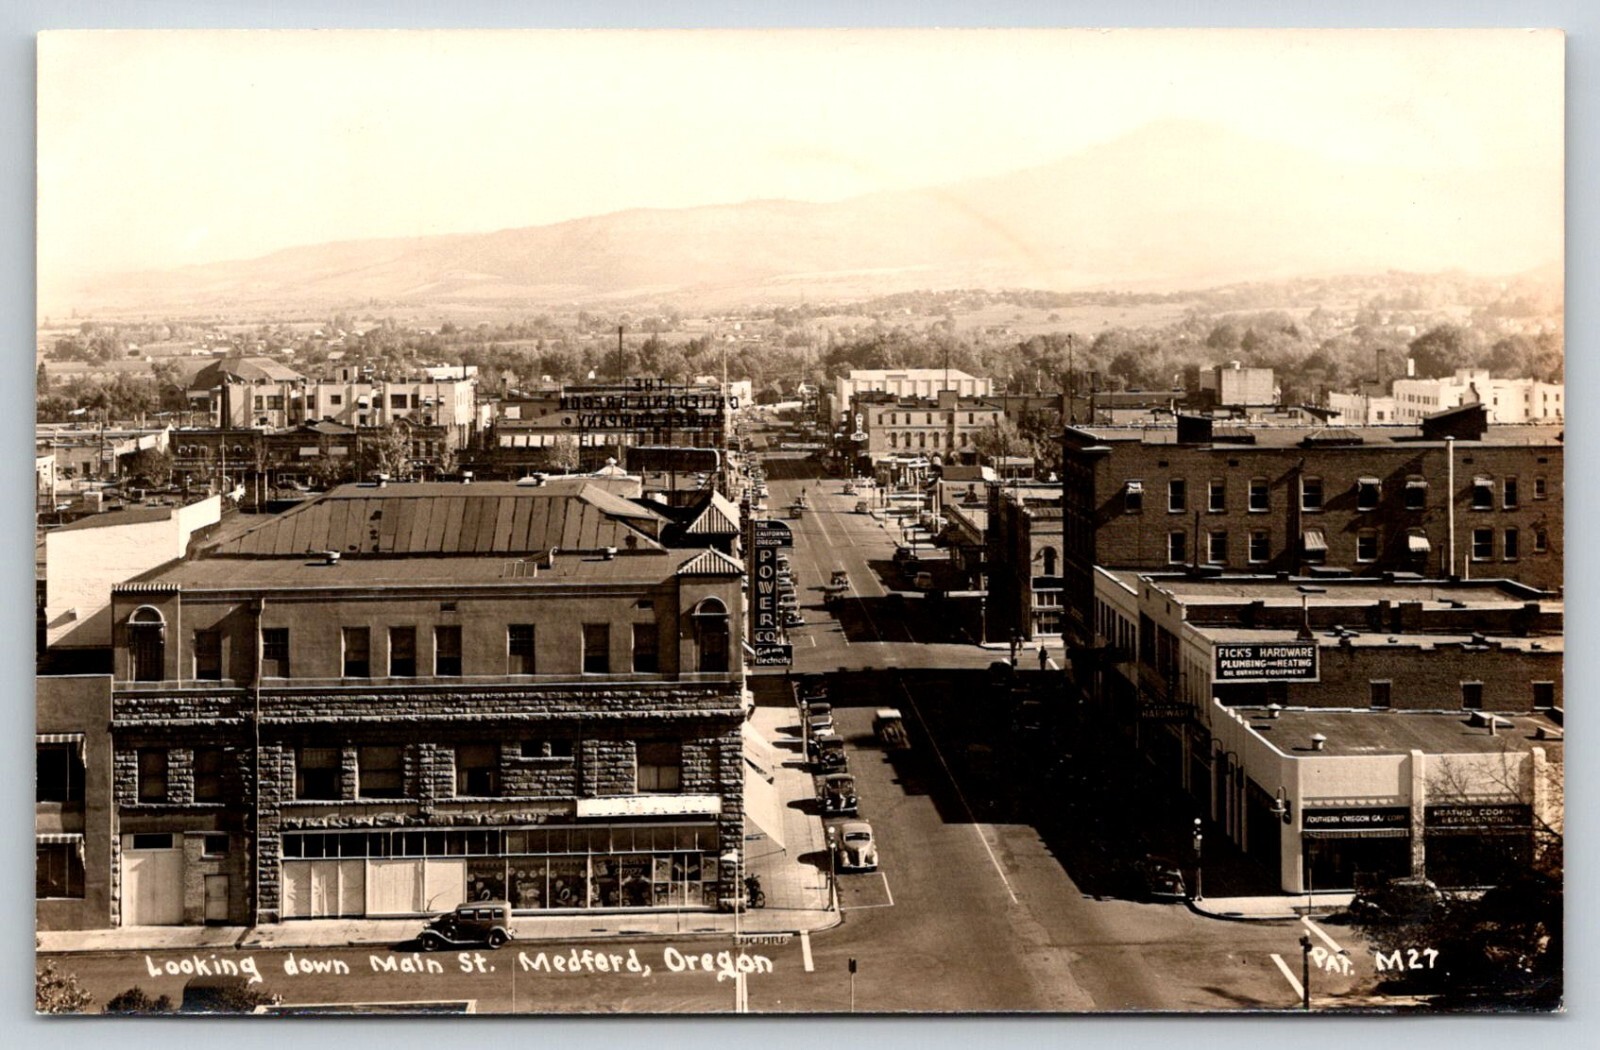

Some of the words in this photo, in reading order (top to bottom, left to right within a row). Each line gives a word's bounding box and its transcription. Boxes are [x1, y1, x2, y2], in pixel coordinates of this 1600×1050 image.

[757, 550, 775, 626] POWER
[1218, 648, 1253, 658] FICK'S
[1259, 647, 1314, 657] HARDWARE
[1221, 659, 1267, 668] PLUMBING
[1277, 659, 1313, 667] HEATING
[1265, 668, 1307, 676] EQUIPMENT
[1306, 815, 1340, 823] SOUTHERN
